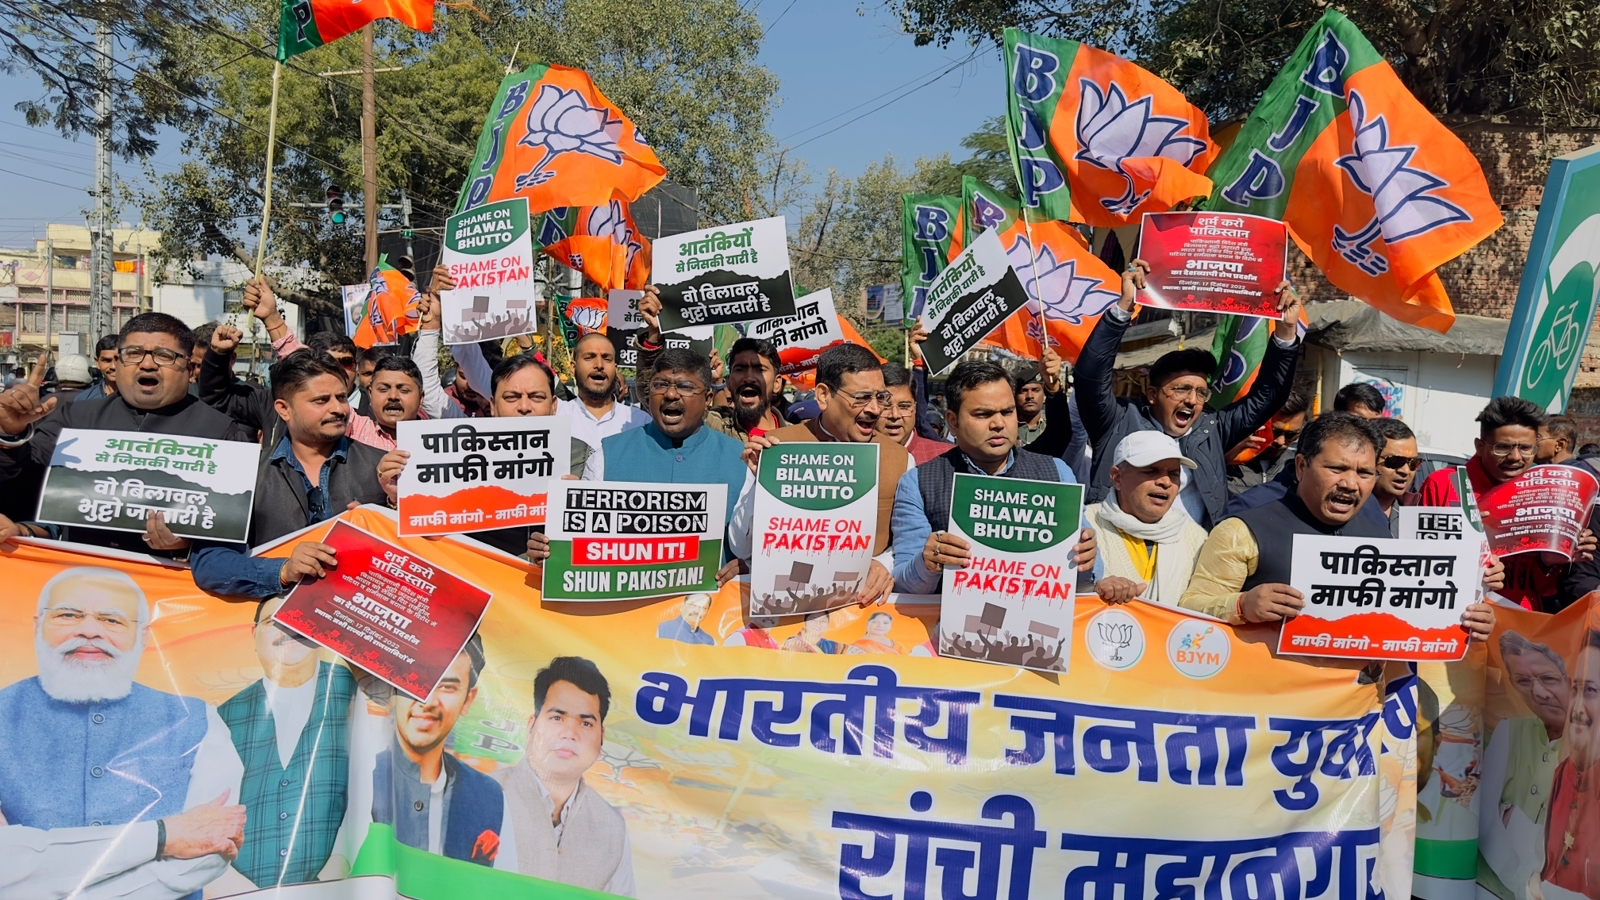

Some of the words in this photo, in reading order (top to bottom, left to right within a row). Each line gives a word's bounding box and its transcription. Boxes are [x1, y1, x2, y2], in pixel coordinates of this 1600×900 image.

[458, 211, 492, 228] SHAME
[494, 208, 511, 219] ON
[1198, 216, 1219, 227] शर्म
[1220, 217, 1244, 228] करो
[455, 219, 514, 241] BILAWAL
[457, 232, 512, 250] BHUTTO
[1189, 225, 1250, 238] पाकिस्तान
[679, 227, 754, 257] आतंकियों
[451, 259, 498, 275] SHAME
[501, 256, 521, 267] ON
[675, 261, 685, 273] से
[686, 253, 724, 272] जिसकी
[726, 252, 750, 266] यारी
[751, 248, 758, 264] है
[1186, 259, 1244, 273] भाजपा
[927, 249, 976, 305] आतंकियों
[682, 285, 698, 303] वो
[699, 281, 760, 301] बिलावल
[928, 309, 937, 319] से
[935, 284, 963, 313] जिसकी
[961, 270, 980, 289] यारी
[977, 265, 986, 277] है
[680, 303, 709, 323] भुट्टो
[709, 296, 758, 318] जरदारी
[759, 292, 771, 312] है
[941, 322, 955, 340] वो
[952, 289, 995, 327] बिलावल
[788, 317, 828, 344] मांगो
[942, 333, 965, 358] भुट्टो
[961, 302, 1000, 340] जरदारी
[995, 296, 1008, 313] है
[105, 437, 218, 460] आतंकियों
[421, 424, 550, 454] पाकिस्तान
[95, 452, 111, 463] से
[113, 453, 171, 469] जिसकी
[172, 460, 205, 473] यारी
[207, 460, 218, 475] है
[416, 454, 489, 484] माफी
[492, 452, 555, 480] मांगो
[780, 454, 831, 466] SHAME
[833, 454, 855, 466] ON
[775, 468, 858, 483] BILAWAL
[1515, 478, 1580, 489] पाकिस्तान
[1547, 469, 1573, 478] करो
[94, 477, 119, 496] वो
[121, 478, 209, 506] बिलावल
[567, 489, 707, 511] TERRORISM
[780, 484, 854, 500] BHUTTO
[974, 488, 1030, 504] SHAME
[1031, 494, 1056, 507] ON
[78, 497, 123, 522] भुट्टो
[202, 505, 217, 530] है
[409, 510, 448, 527] माफी
[449, 508, 484, 524] मांगो
[495, 503, 528, 520] माफी
[563, 513, 585, 532] IS
[592, 513, 610, 532] A
[617, 514, 708, 533] POISON
[768, 516, 832, 532] SHAME
[834, 519, 862, 533] ON
[969, 503, 1058, 527] BILAWAL
[762, 533, 872, 555] PAKISTAN
[973, 522, 1053, 544] BHUTTO
[586, 542, 655, 561] SHUN
[657, 541, 686, 560] IT!
[1320, 545, 1457, 577] पाकिस्तान
[369, 555, 436, 594] पाकिस्तान
[382, 548, 409, 567] शर्म
[406, 561, 434, 579] करो
[966, 556, 1027, 577] SHAME
[1030, 563, 1061, 579] ON
[562, 570, 611, 592] SHUN
[616, 566, 703, 591] PAKISTAN!
[953, 571, 1071, 602] PAKISTAN
[1311, 578, 1386, 607] माफी
[1389, 578, 1458, 610] मांगो
[350, 591, 412, 629] भाजपा
[355, 621, 363, 629] 17
[382, 636, 400, 649] 2022
[1292, 633, 1332, 648] माफी
[1332, 635, 1371, 651] मांगो
[1382, 636, 1421, 653] माफी
[1421, 637, 1458, 653] मांगो
[1176, 651, 1220, 665] BJYM
[634, 665, 981, 767] भारतीय
[994, 694, 1255, 786] जनता
